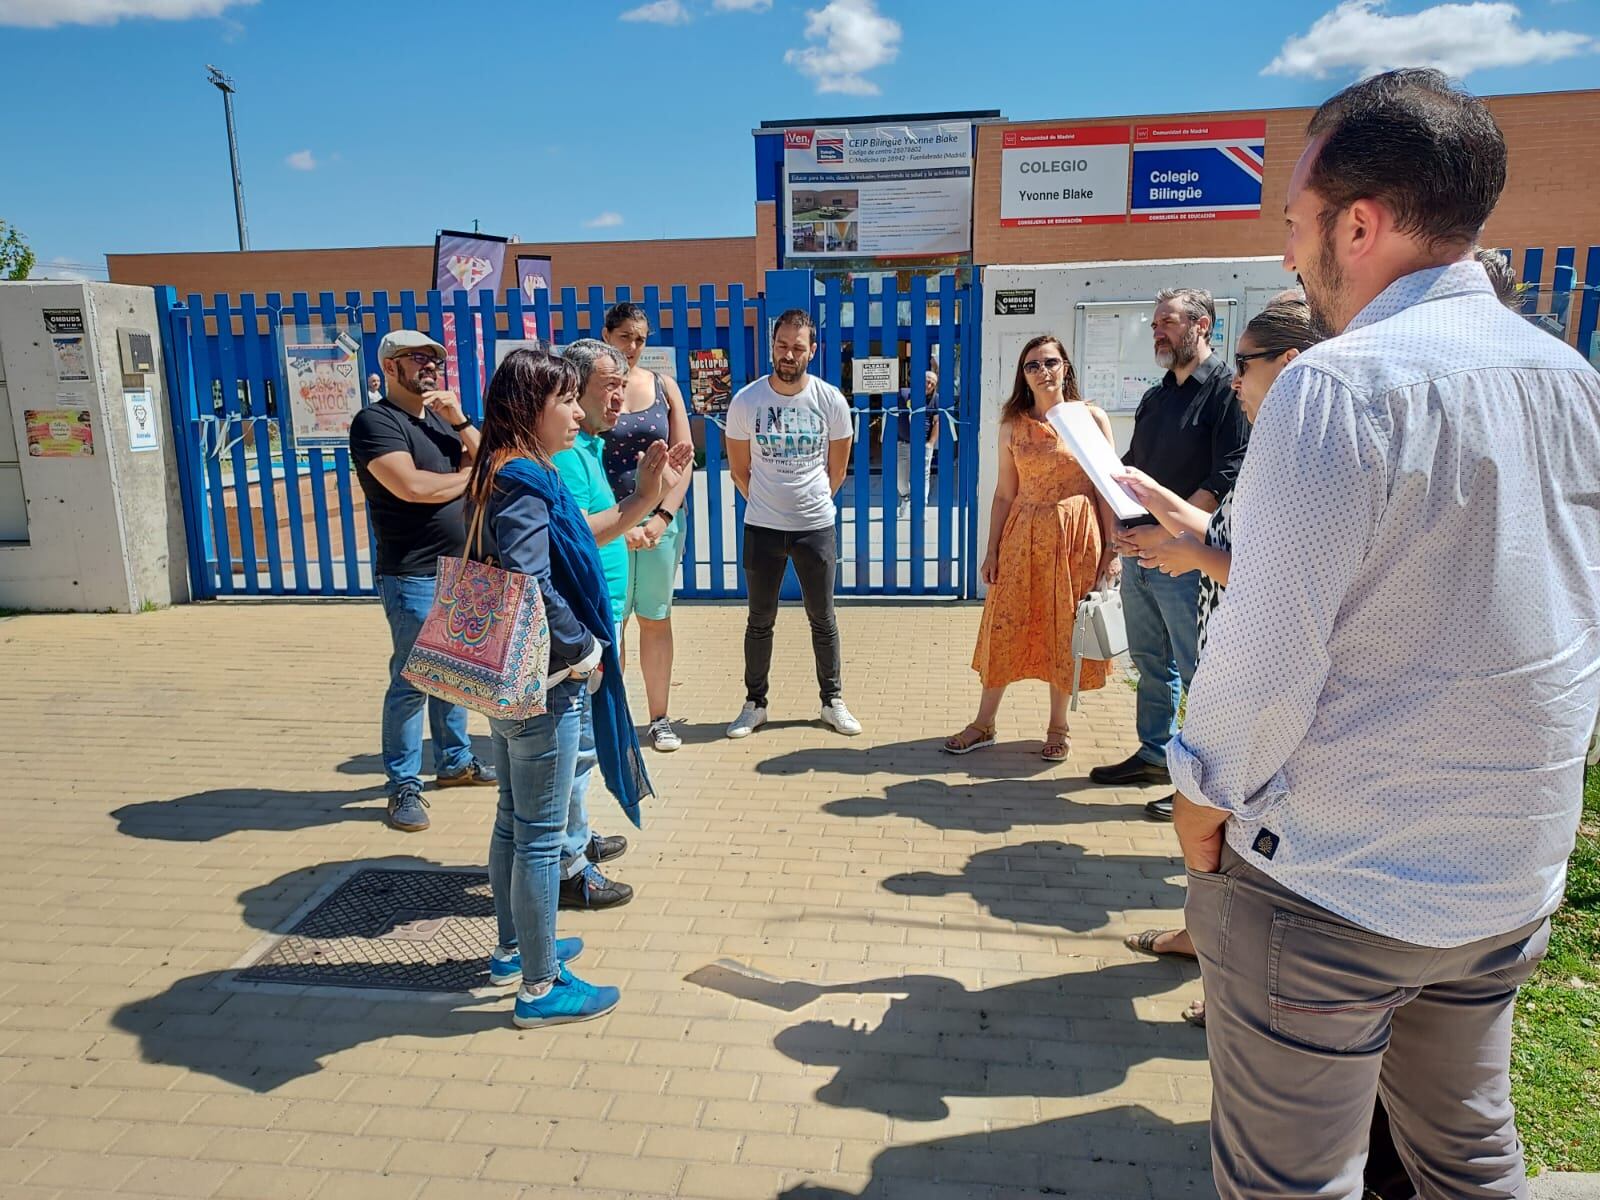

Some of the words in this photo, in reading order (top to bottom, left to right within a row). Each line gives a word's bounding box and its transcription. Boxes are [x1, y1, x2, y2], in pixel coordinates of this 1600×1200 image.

[848, 138, 869, 148] CEIP
[904, 136, 934, 144] Yvonne
[936, 134, 958, 144] Blake
[1020, 160, 1088, 174] COLEGIO
[1150, 170, 1199, 184] Colegio
[1019, 190, 1060, 201] Yvonne
[1063, 188, 1093, 200] Blake
[1150, 187, 1202, 201] Bilingüe
[304, 394, 352, 414] SCHOOL
[756, 406, 762, 433] I
[767, 406, 824, 434] NEED
[756, 434, 823, 458] BEACH
